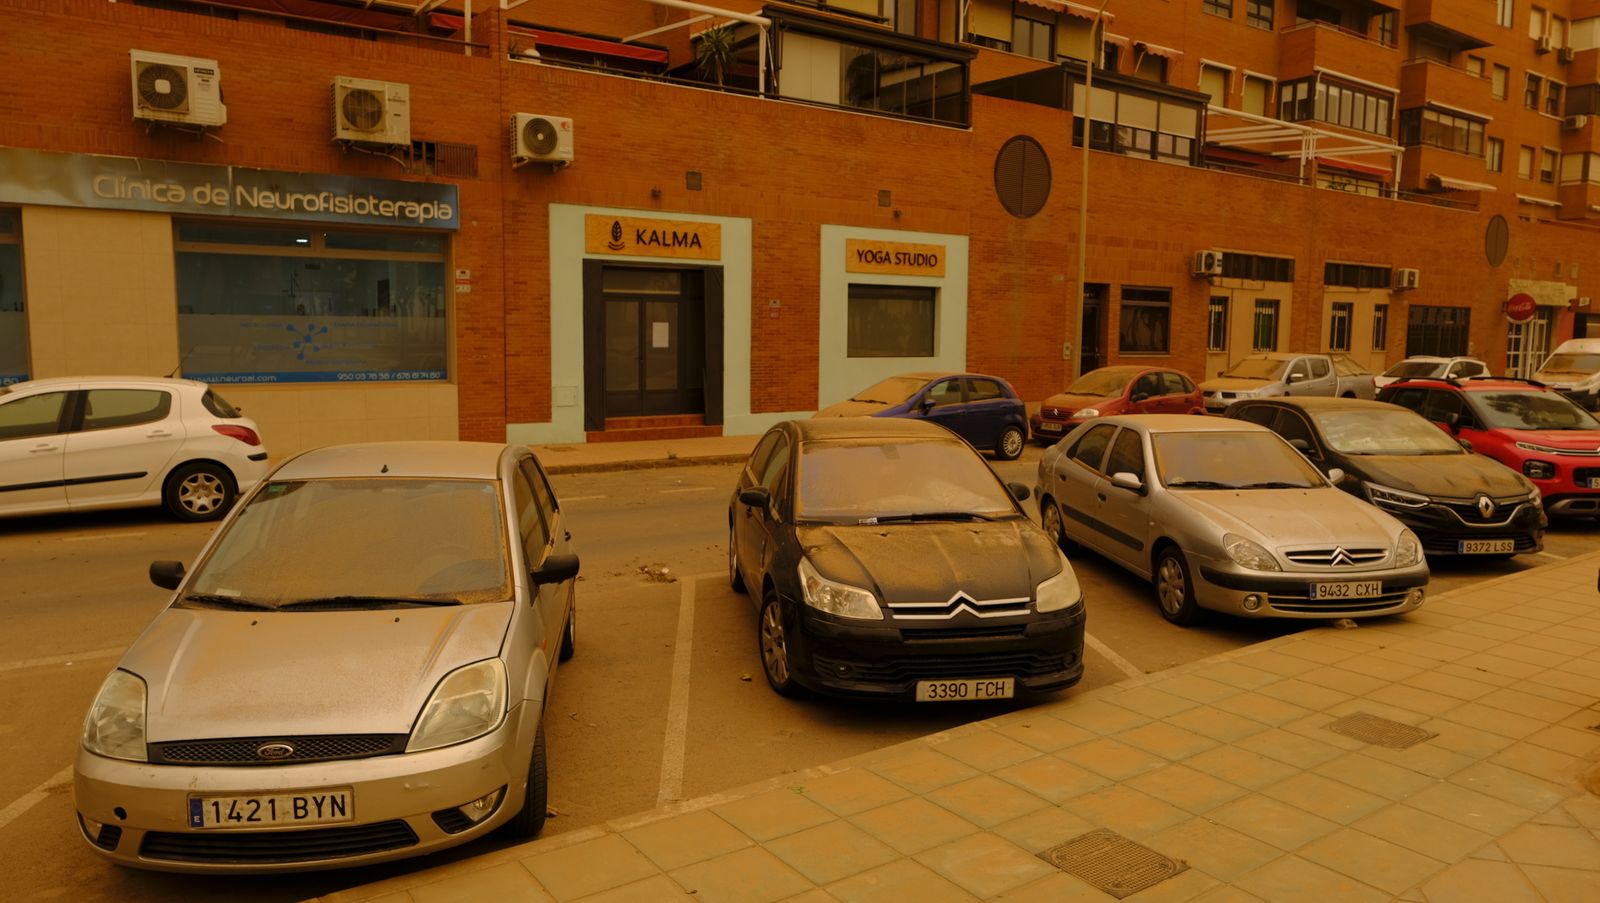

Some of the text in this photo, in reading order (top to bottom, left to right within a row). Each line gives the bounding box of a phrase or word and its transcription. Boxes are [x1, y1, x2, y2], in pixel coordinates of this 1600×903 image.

[93, 175, 453, 223] Clínica de Neurofisioterapia
[636, 228, 702, 249] KALMA
[856, 249, 938, 267] YOGA STUDIO
[1466, 542, 1513, 552] 9372 LSS
[1319, 584, 1350, 598] 9432
[1355, 583, 1379, 597] CXH
[928, 681, 1005, 699] 3390 FCH
[211, 798, 277, 824] 1421
[292, 794, 347, 820] BYN
